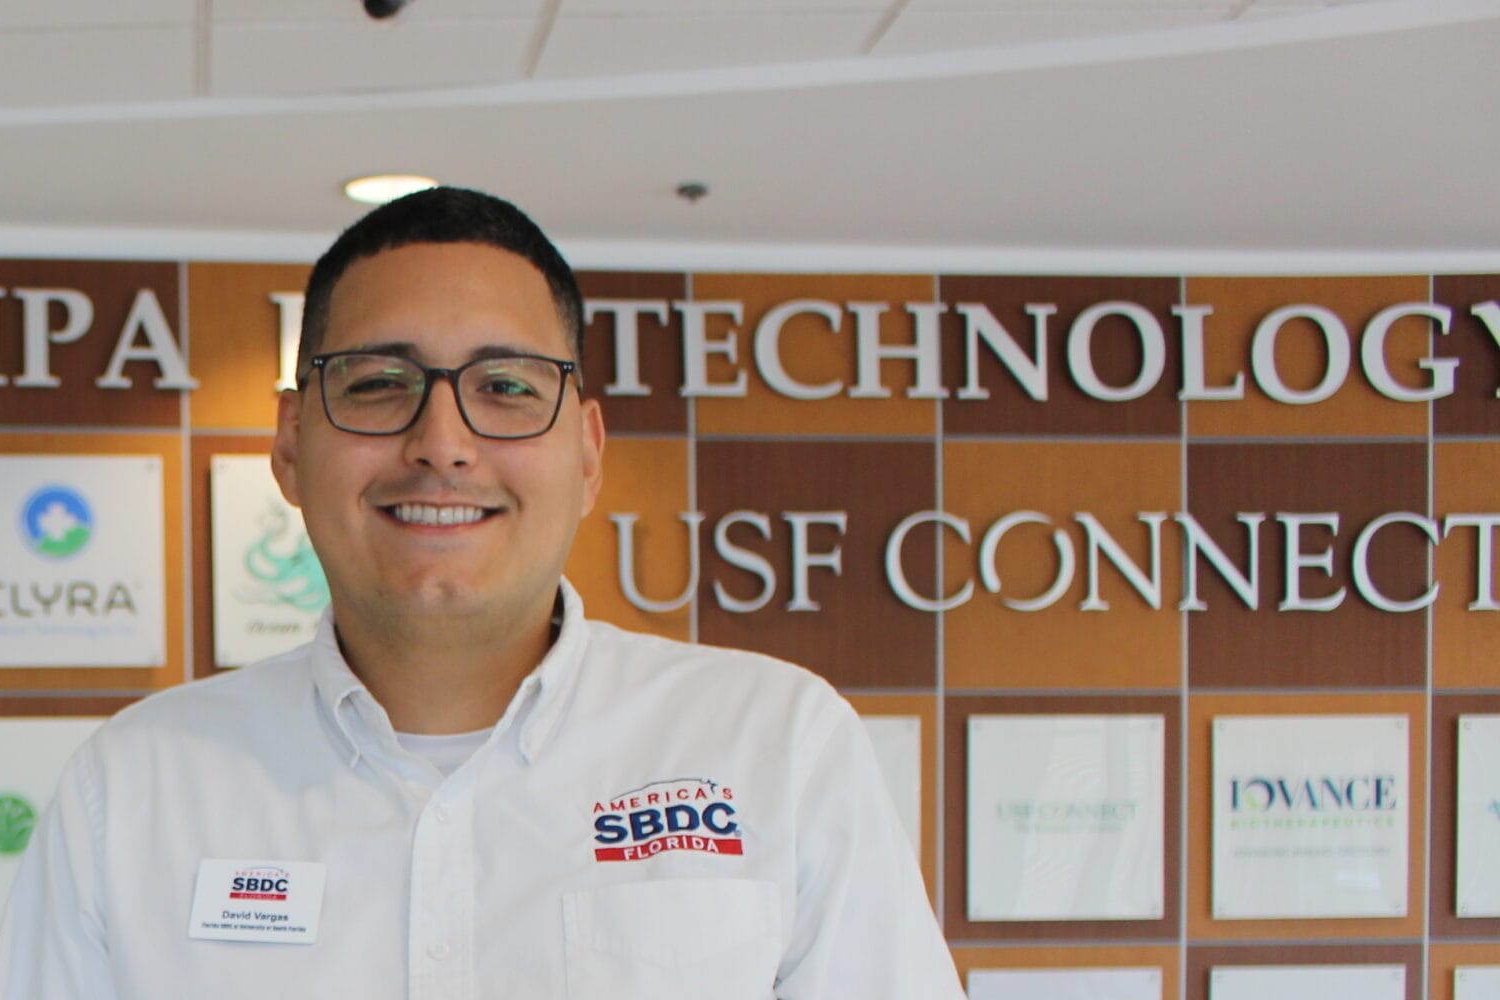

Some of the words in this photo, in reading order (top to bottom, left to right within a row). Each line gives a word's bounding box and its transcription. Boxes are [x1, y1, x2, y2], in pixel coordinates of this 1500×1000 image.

[609, 509, 849, 612] USF
[885, 510, 1500, 612] CONNECT
[1231, 776, 1397, 811] IOVANCE
[594, 802, 738, 844] SBDC
[623, 836, 719, 862] FLORIDA
[232, 877, 289, 892] SBDC
[222, 910, 252, 920] David
[254, 912, 289, 922] Vargas
